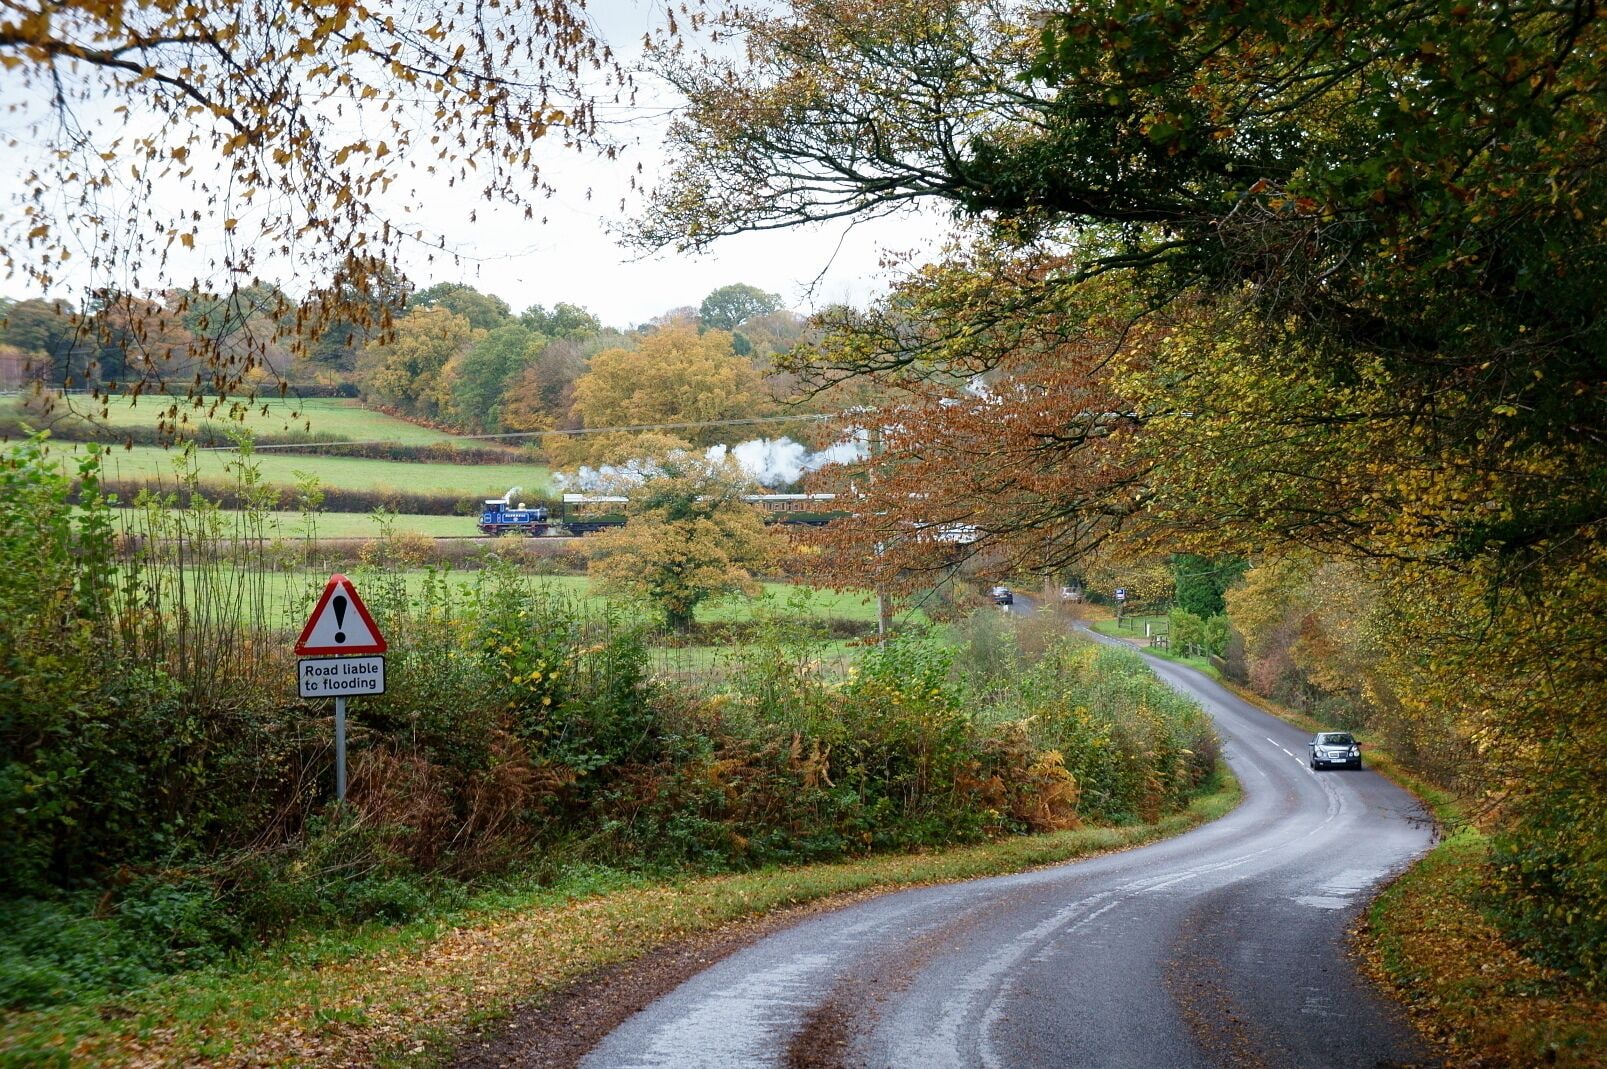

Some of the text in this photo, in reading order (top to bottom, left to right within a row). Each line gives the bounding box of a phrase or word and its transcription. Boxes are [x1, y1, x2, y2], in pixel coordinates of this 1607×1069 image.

[305, 663, 378, 677] Road liable
[305, 678, 376, 691] to flooding
